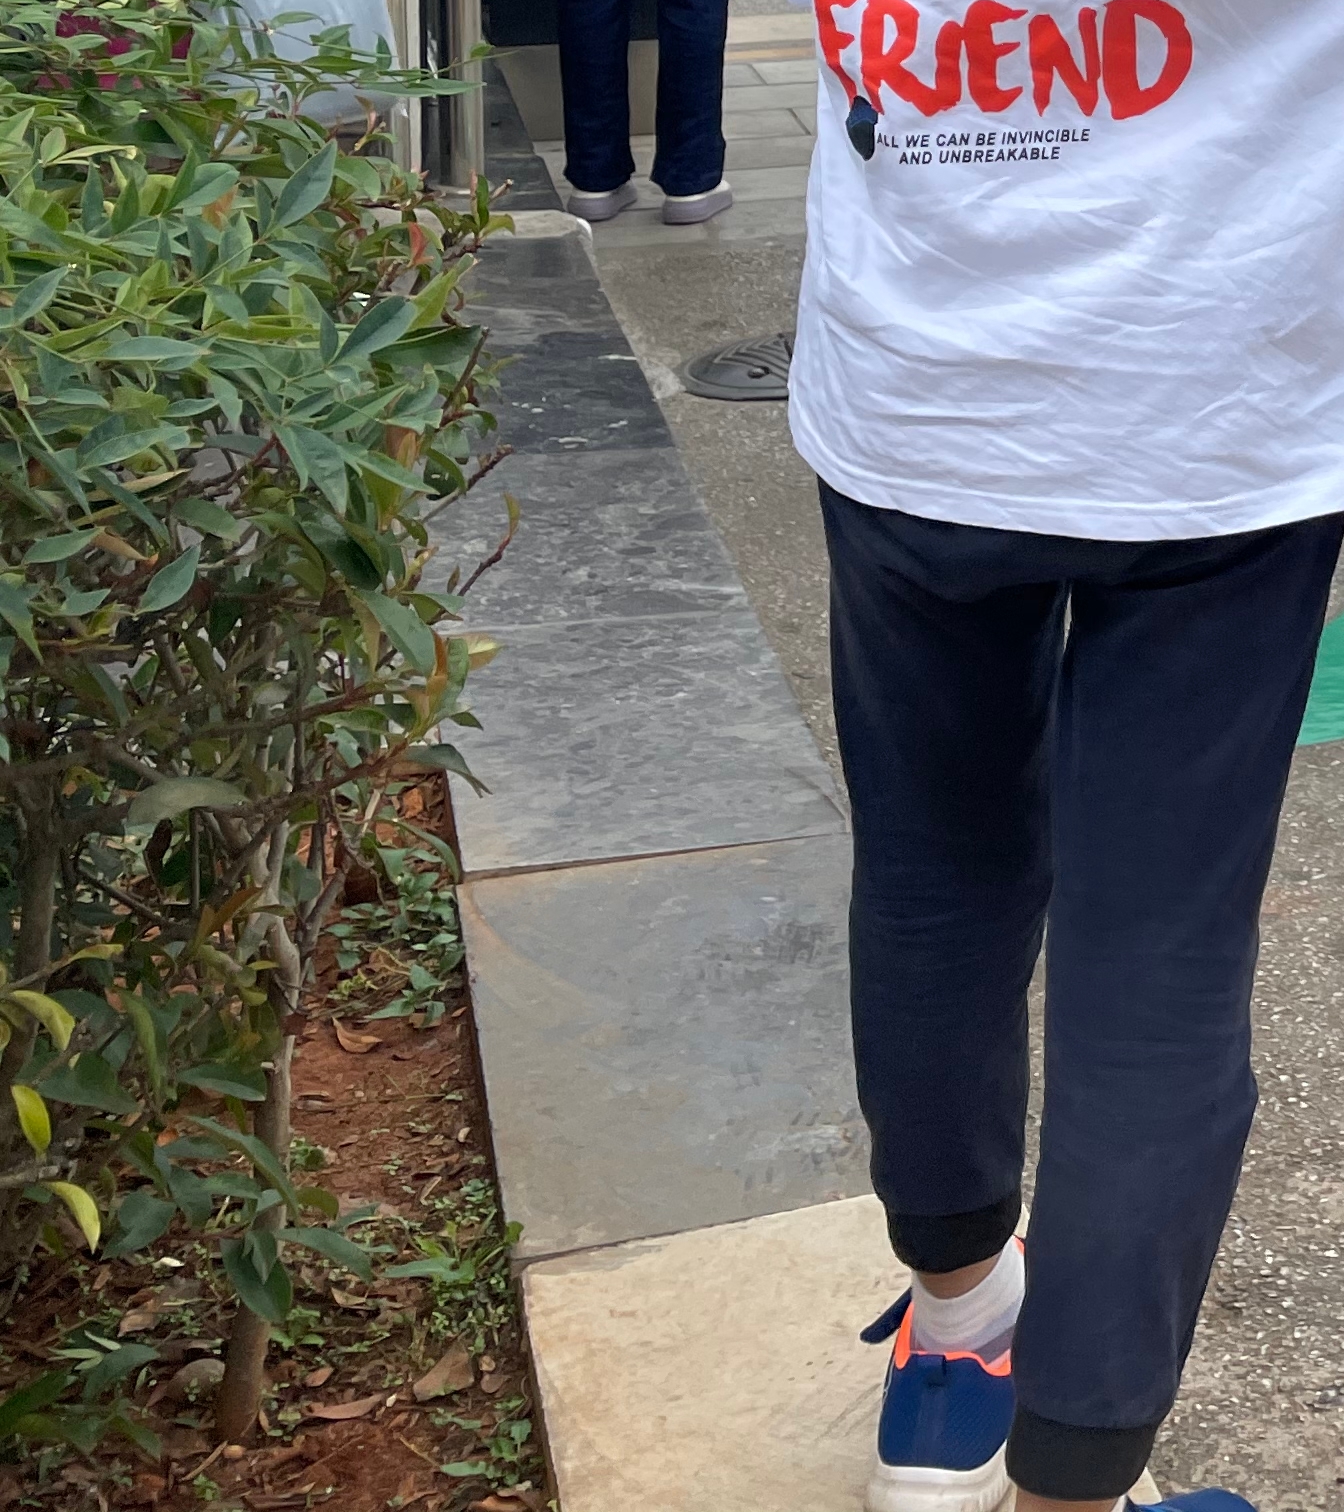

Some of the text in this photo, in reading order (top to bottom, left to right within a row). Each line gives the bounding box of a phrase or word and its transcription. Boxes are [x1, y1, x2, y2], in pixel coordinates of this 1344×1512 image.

[876, 128, 1091, 148] ALL WE CAN BE INVINCIBLE
[898, 146, 1061, 165] AND UNBREAKABLE
